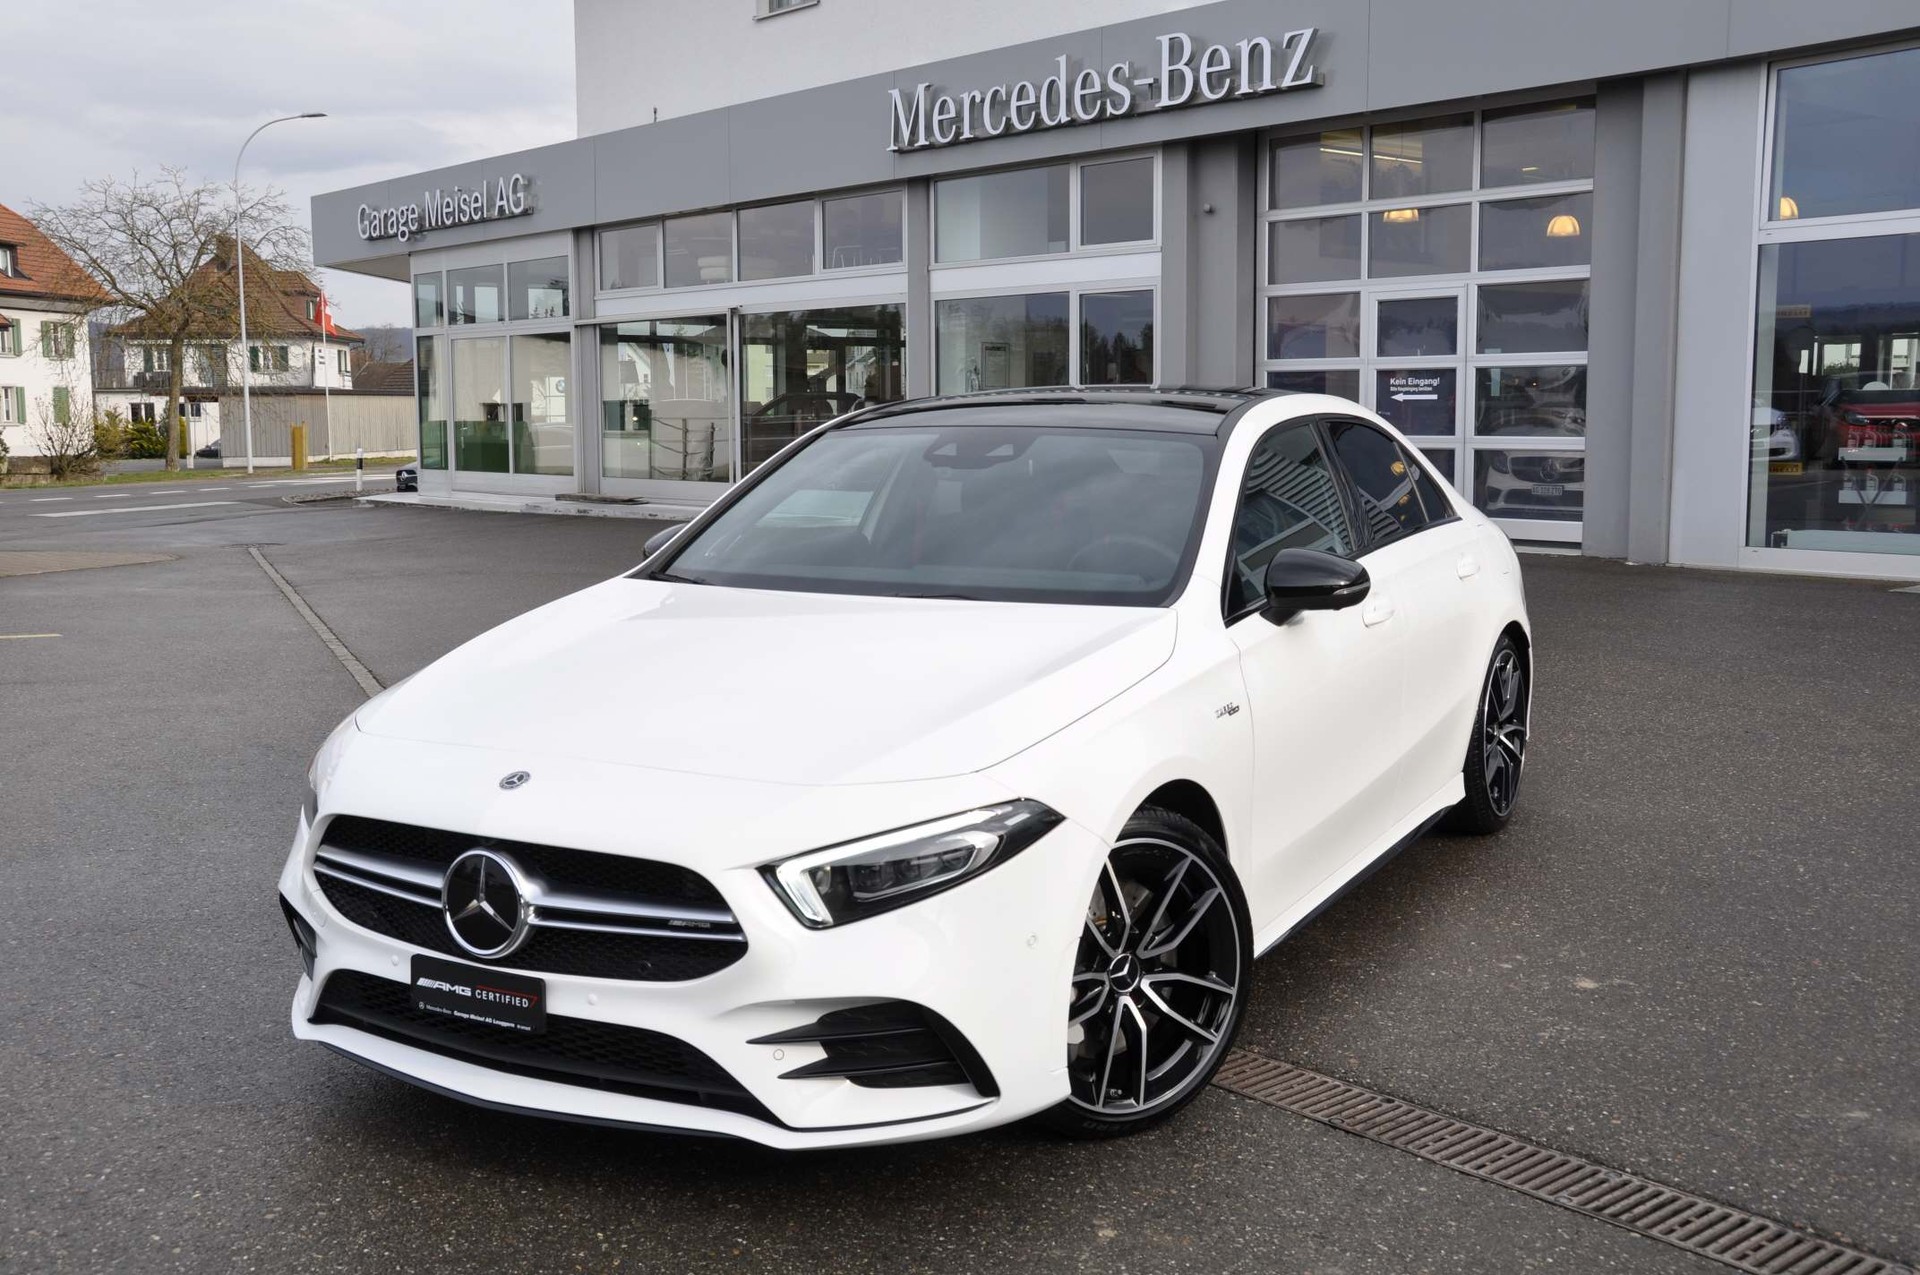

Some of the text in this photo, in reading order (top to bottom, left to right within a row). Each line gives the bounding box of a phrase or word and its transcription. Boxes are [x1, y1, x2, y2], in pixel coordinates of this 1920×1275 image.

[887, 27, 1319, 152] Mercedes-Benz
[358, 173, 525, 242] Garage Meisel AG
[1390, 377, 1440, 386] Kein Eingang!
[432, 981, 529, 1008] AMG CERTIFIED
